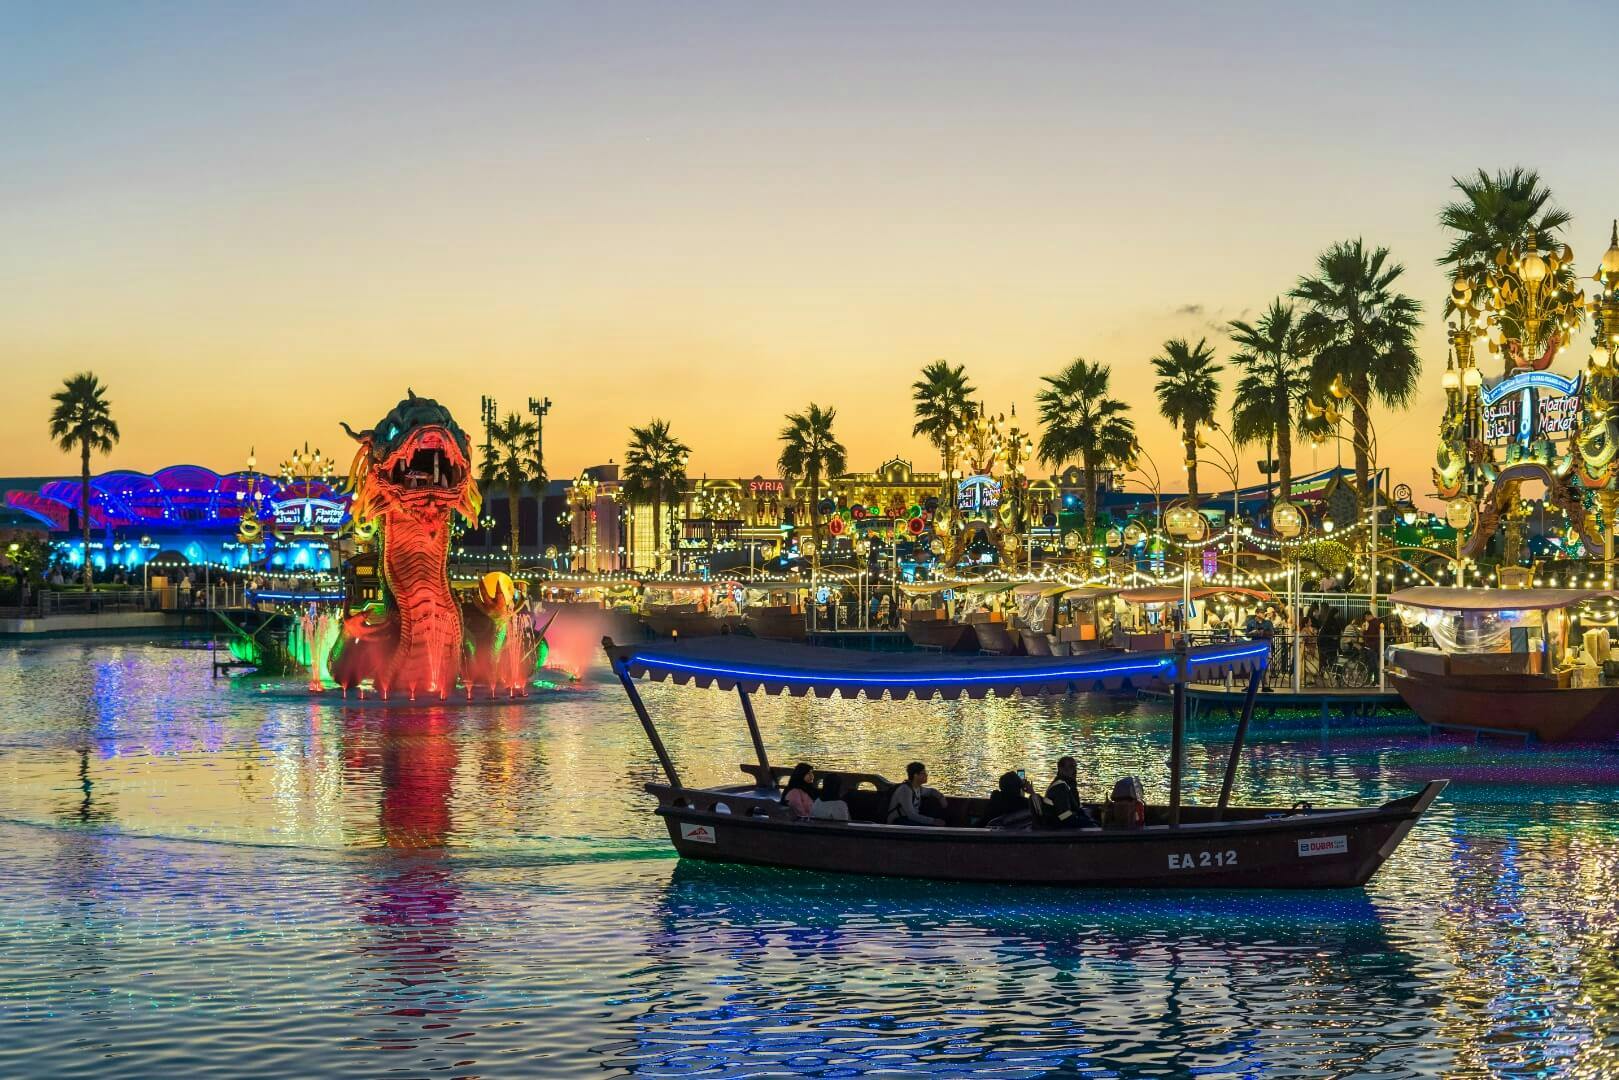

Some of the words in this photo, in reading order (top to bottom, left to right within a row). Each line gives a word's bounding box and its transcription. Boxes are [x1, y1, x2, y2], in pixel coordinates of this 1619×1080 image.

[1482, 400, 1515, 422] السوق
[1538, 394, 1579, 413] Floating
[1538, 411, 1576, 433] Market
[750, 481, 784, 491] SYRIA
[1168, 853, 1195, 869] EA
[1199, 850, 1238, 867] 212
